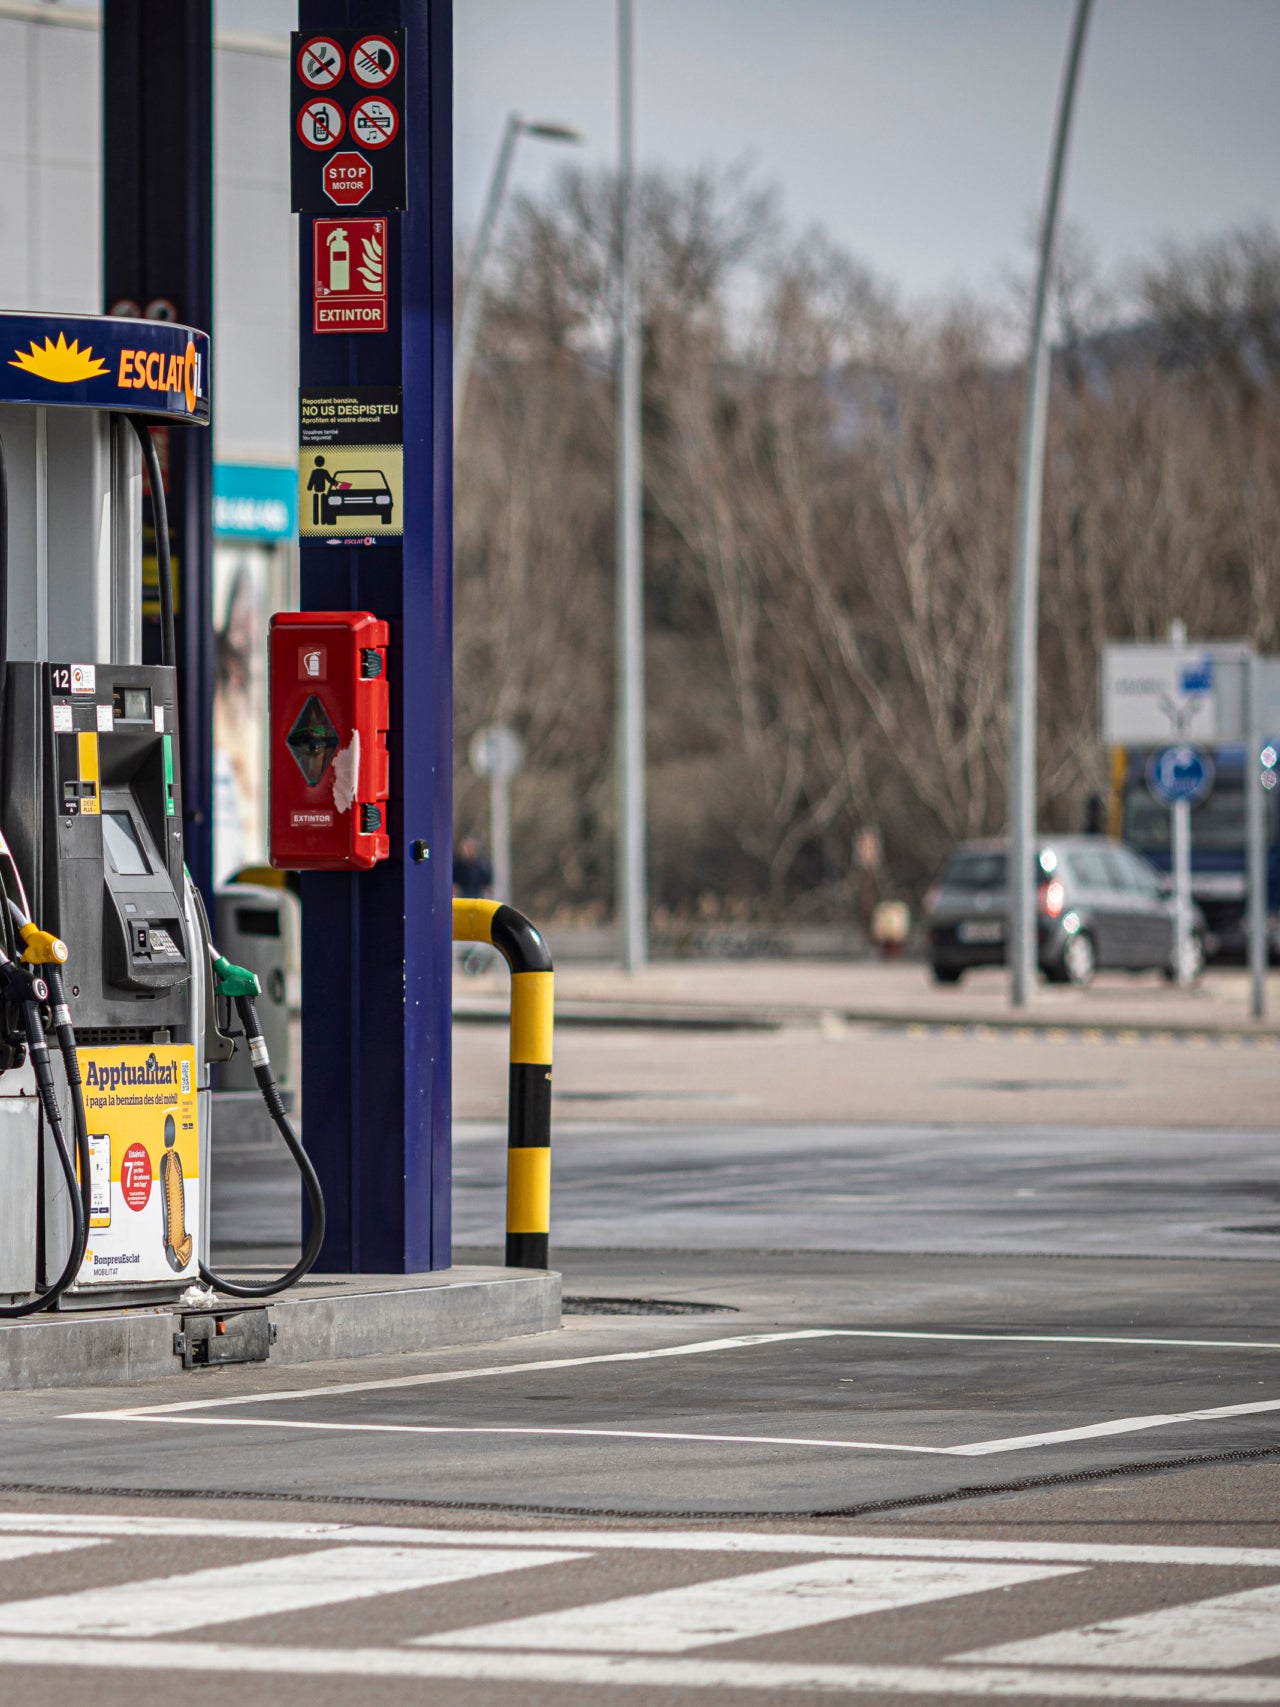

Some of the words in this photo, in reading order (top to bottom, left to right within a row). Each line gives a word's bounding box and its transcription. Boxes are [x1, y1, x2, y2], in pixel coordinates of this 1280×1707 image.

[329, 167, 367, 179] STOP
[332, 181, 364, 190] MOTOR
[319, 308, 381, 322] EXTINTOR
[302, 406, 318, 416] NO
[320, 405, 335, 416] US
[338, 404, 399, 416] DESPISTEU
[53, 669, 70, 688] 12
[293, 814, 330, 822] EXTINTOR
[422, 848, 429, 859] 12
[90, 1097, 107, 1108] paga
[108, 1094, 115, 1106] la
[116, 1094, 143, 1106] benzina
[144, 1093, 154, 1105] des
[155, 1093, 163, 1105] del
[124, 1161, 134, 1188] 7
[94, 1253, 140, 1266] BonpreuEsclat
[93, 1268, 118, 1276] MOBILITAT
